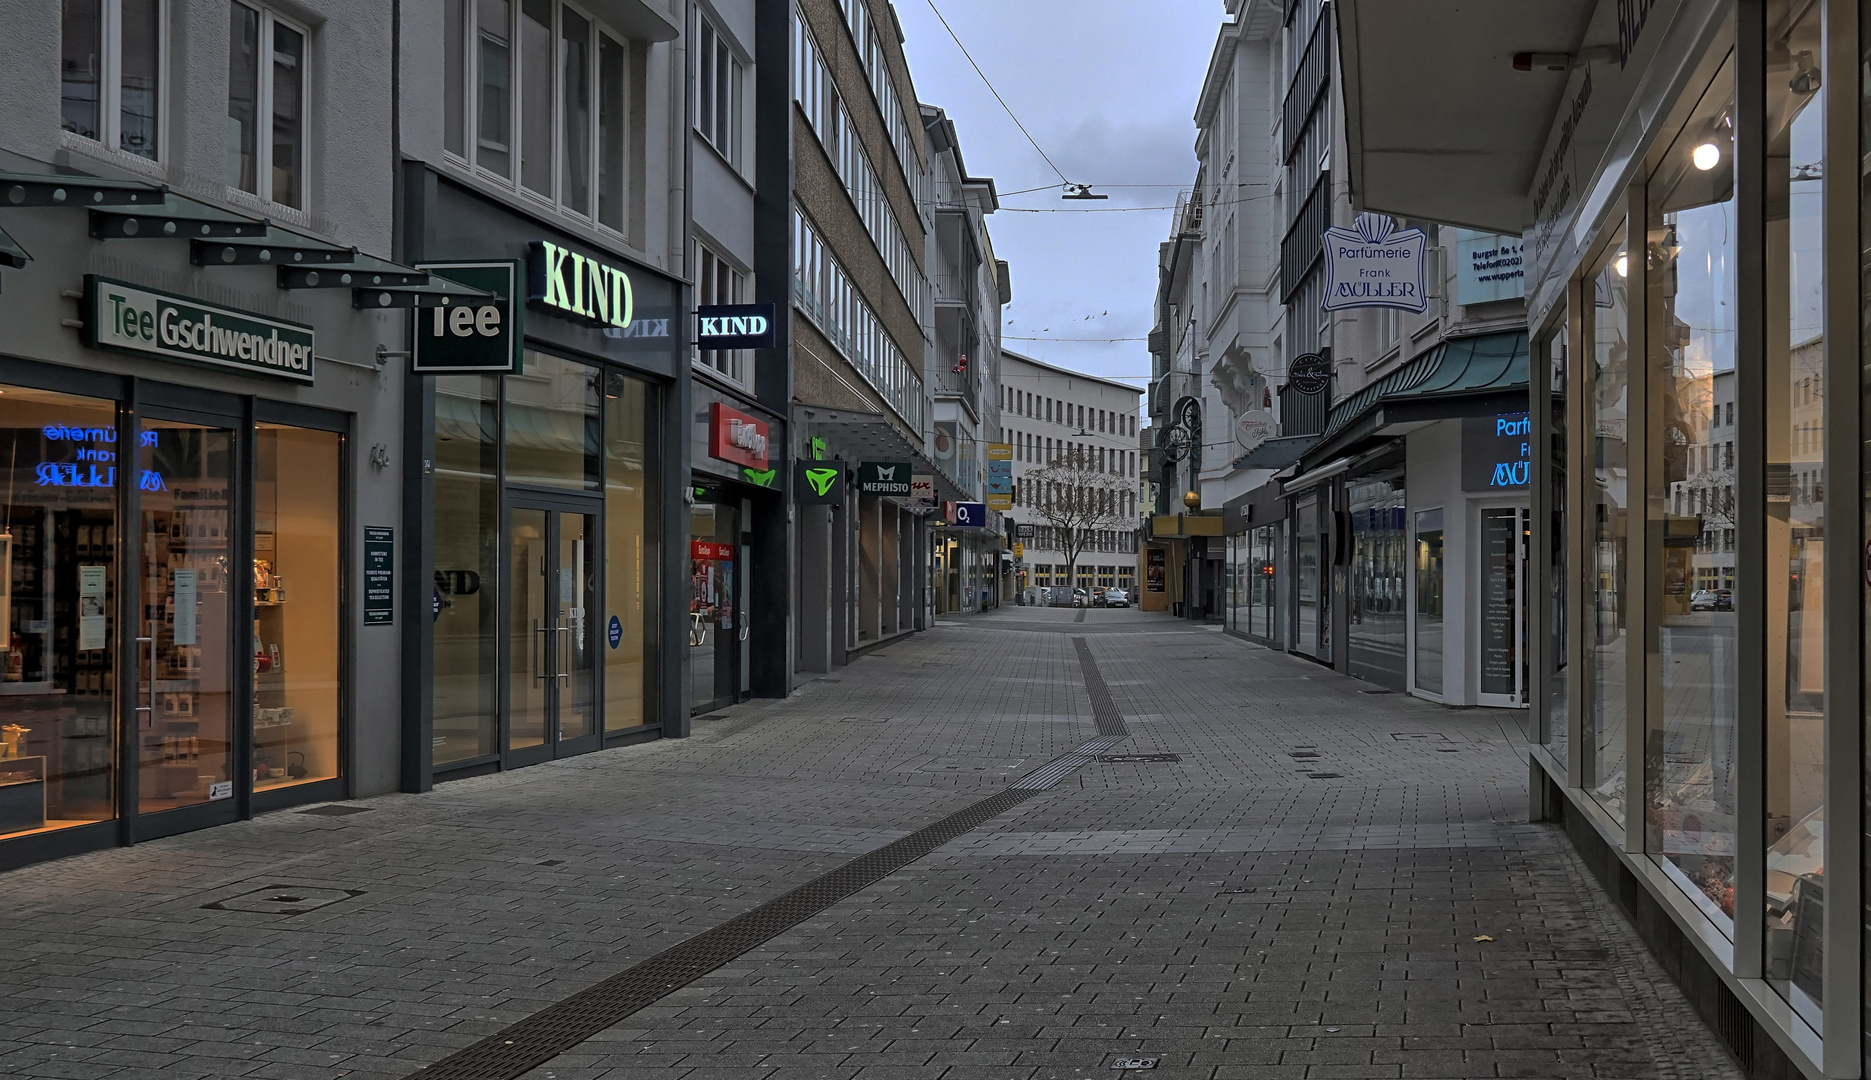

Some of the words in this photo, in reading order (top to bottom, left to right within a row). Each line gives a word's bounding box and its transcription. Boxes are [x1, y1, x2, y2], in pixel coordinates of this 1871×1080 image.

[1618, 0, 1656, 72] BILD
[1339, 245, 1411, 260] Parfümerie
[1359, 268, 1391, 278] Frank
[541, 240, 634, 329] KIND
[1334, 281, 1416, 298] MÜLLER
[106, 292, 156, 342] Tee
[159, 306, 314, 372] Gschwendner
[700, 316, 768, 338] KIND
[863, 482, 909, 494] MEPHISTO
